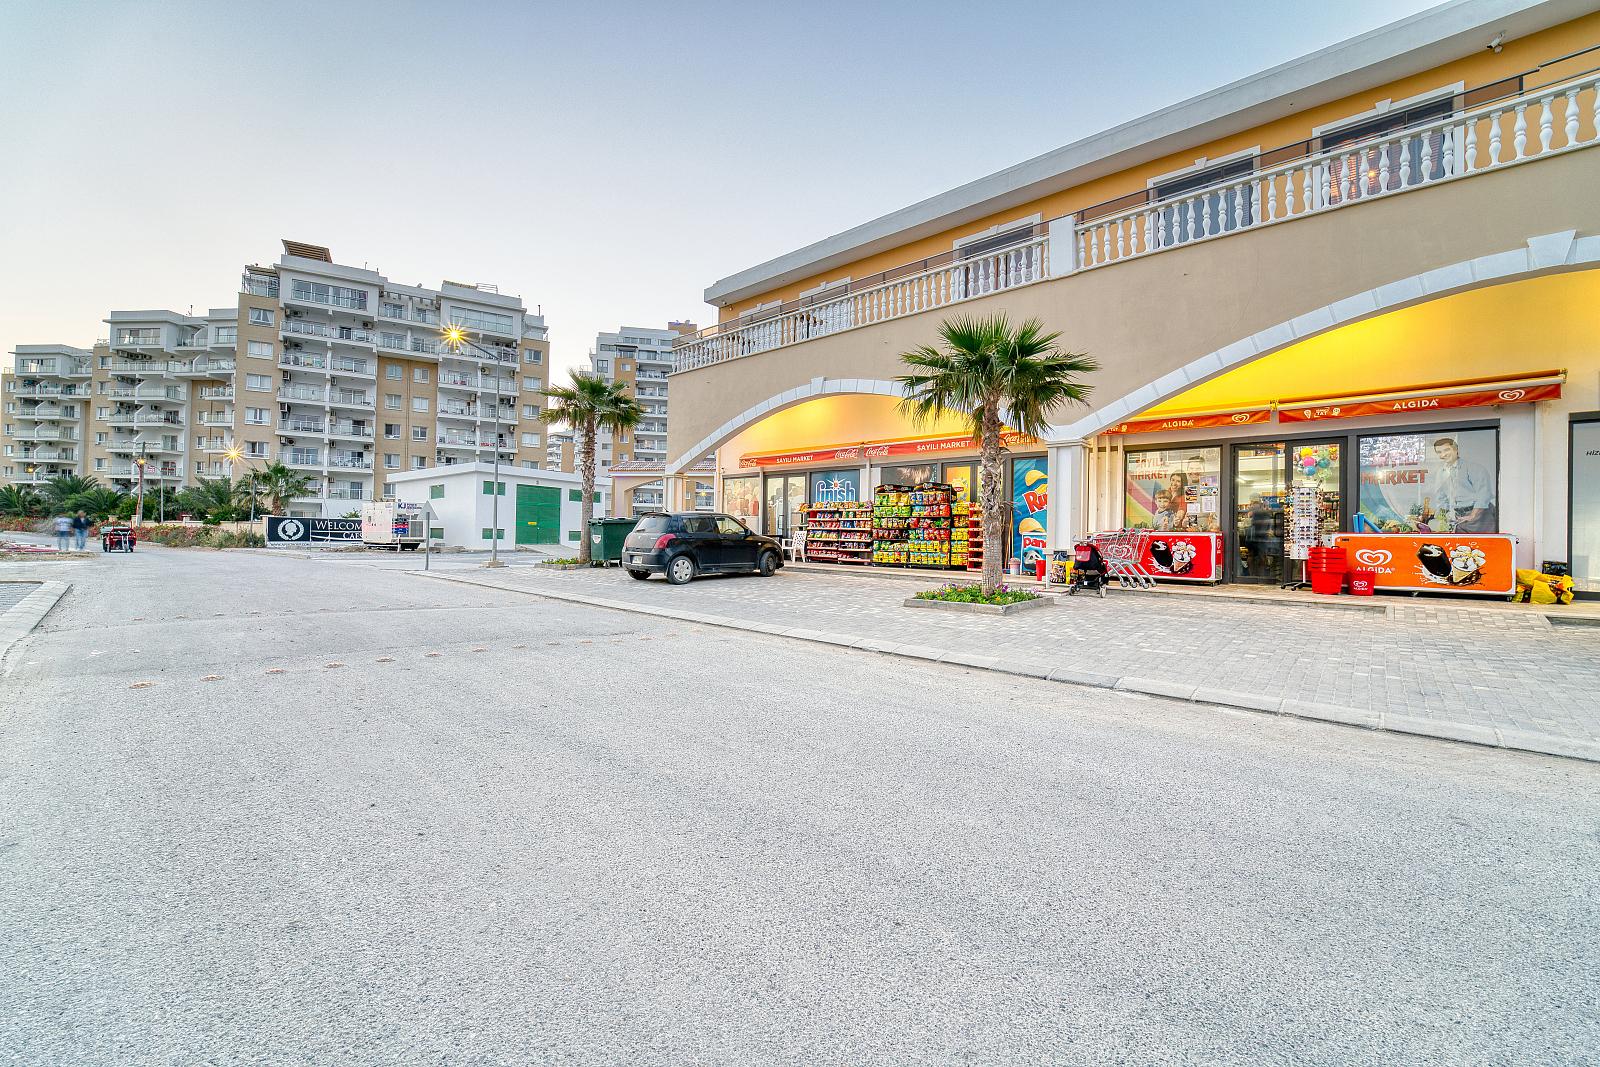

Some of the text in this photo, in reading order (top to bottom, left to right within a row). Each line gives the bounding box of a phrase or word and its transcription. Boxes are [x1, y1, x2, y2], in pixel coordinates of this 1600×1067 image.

[1393, 399, 1438, 410] ALGIDA
[1162, 420, 1193, 428] ALGIDA
[940, 440, 971, 449] MARKET
[792, 454, 814, 463] MARKET
[815, 479, 856, 502] finish
[315, 520, 362, 530] WELCOM
